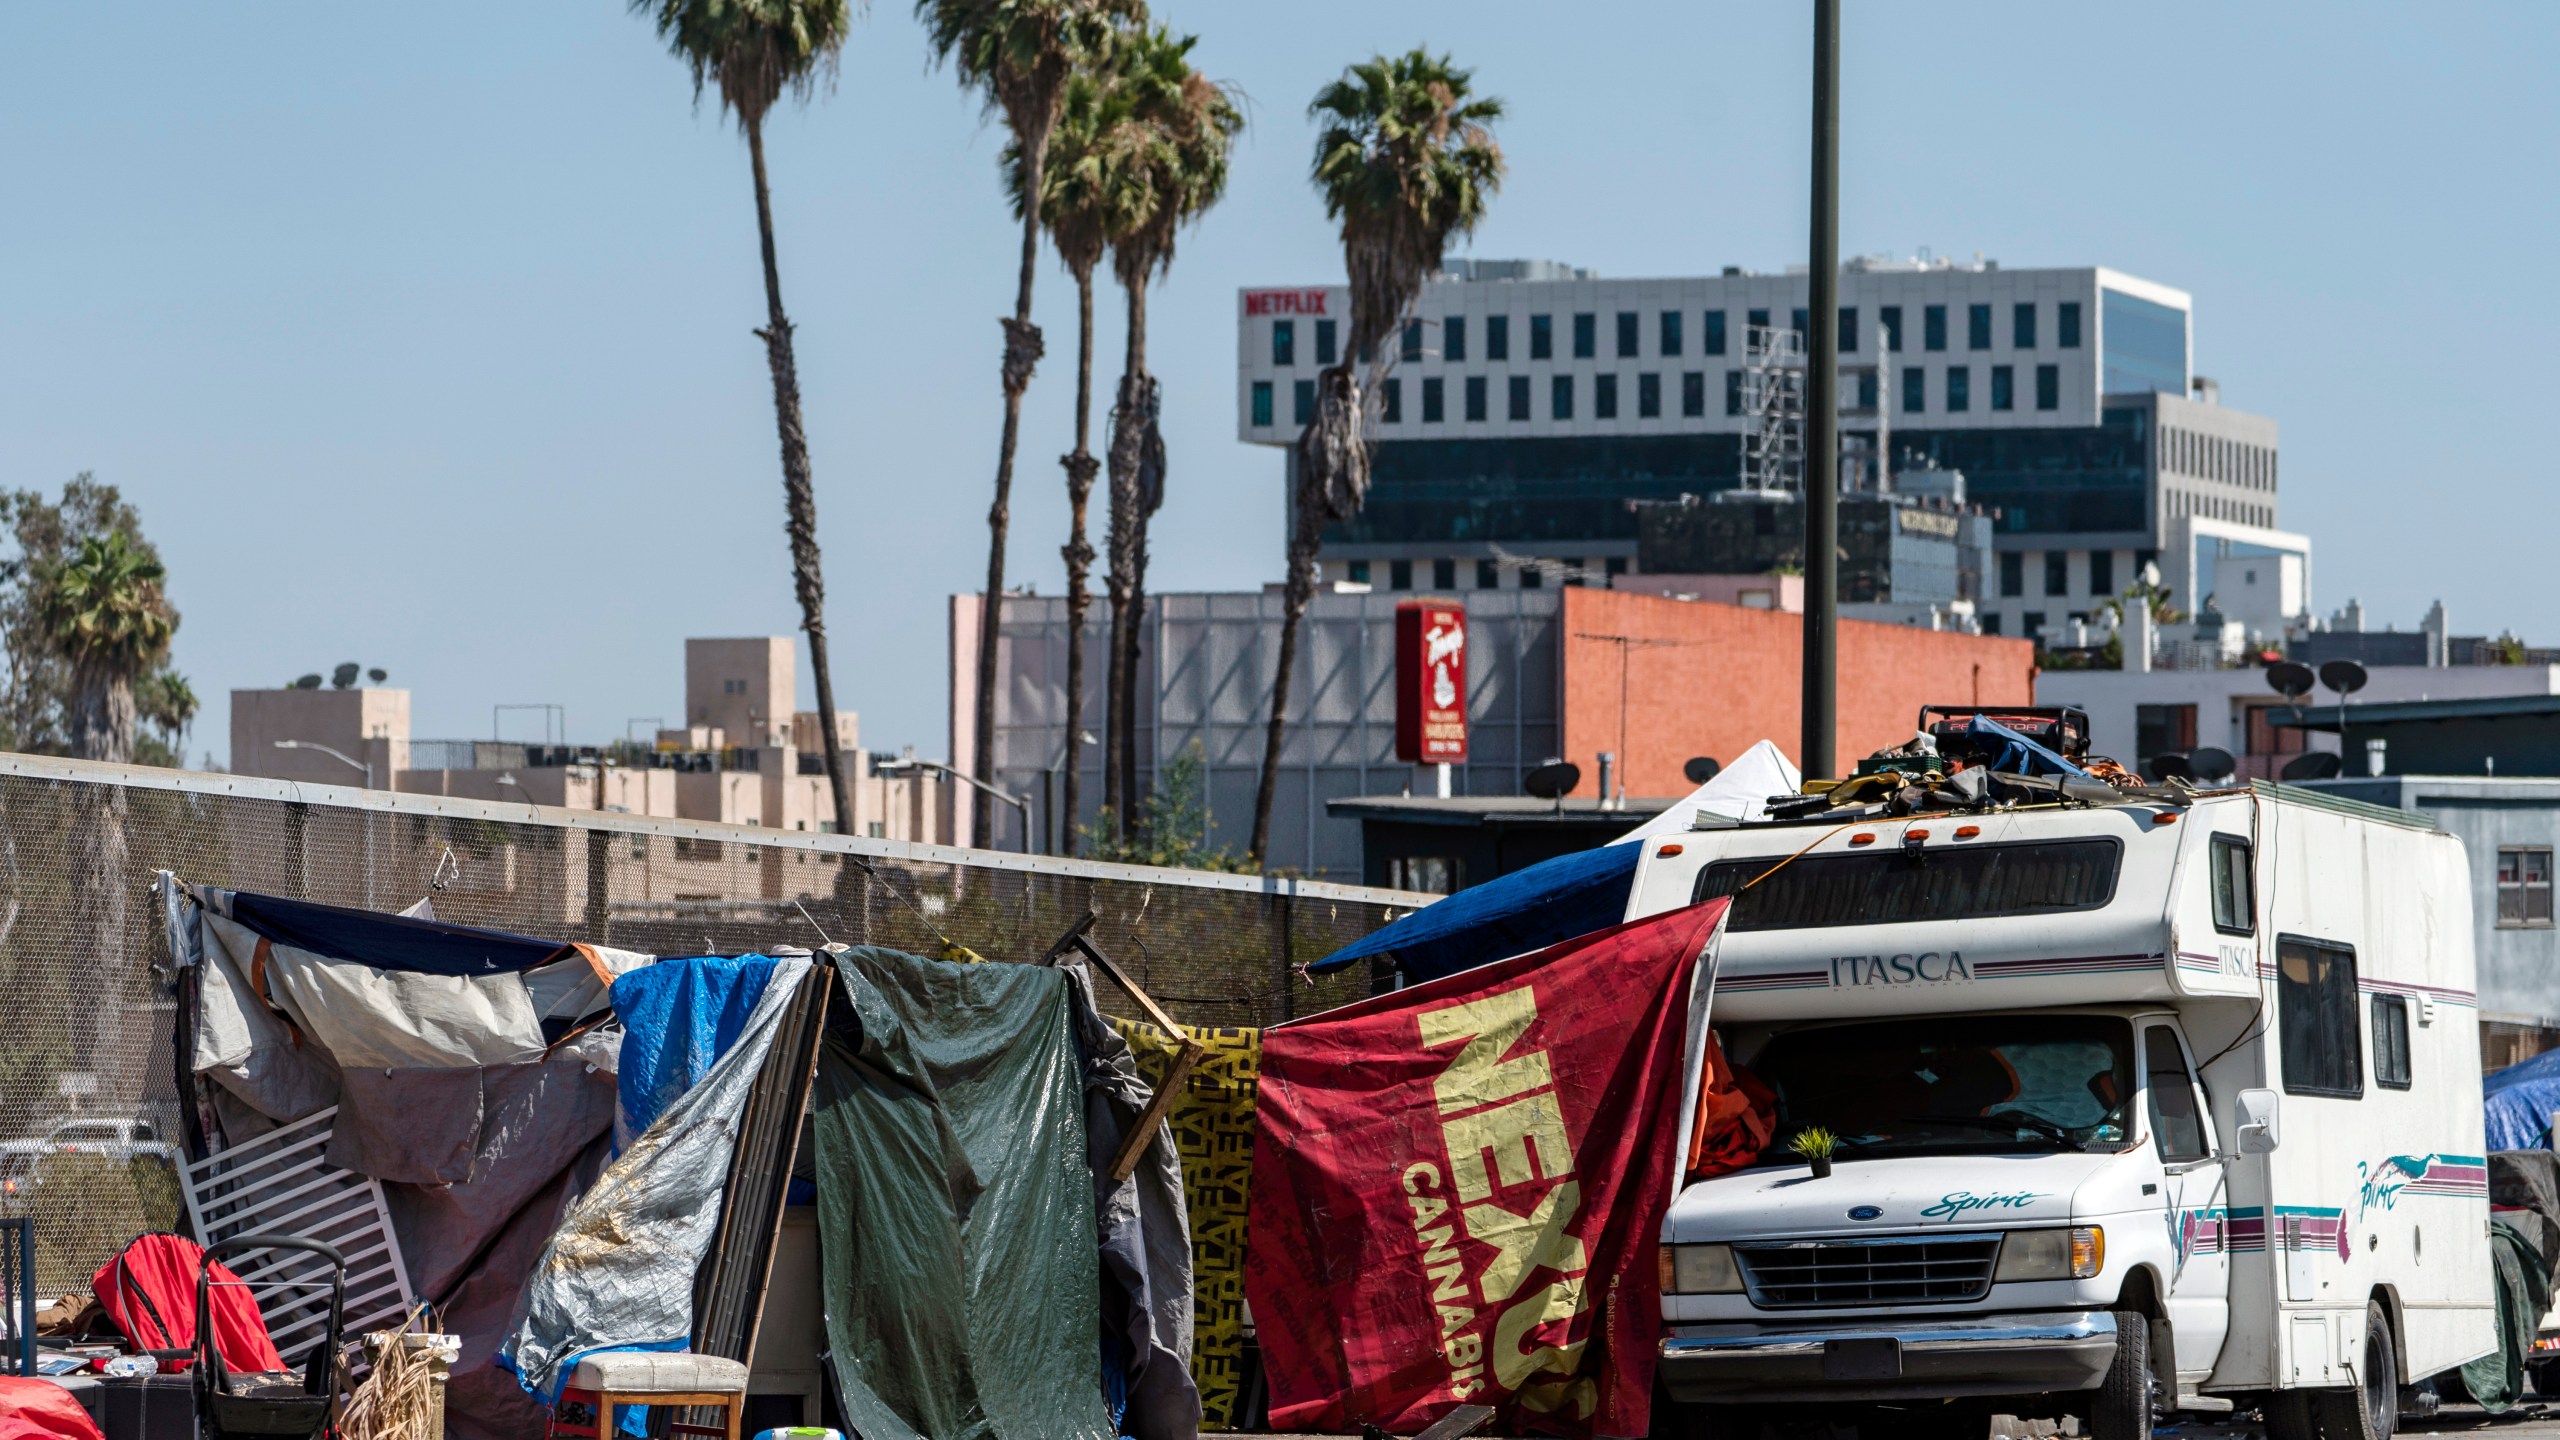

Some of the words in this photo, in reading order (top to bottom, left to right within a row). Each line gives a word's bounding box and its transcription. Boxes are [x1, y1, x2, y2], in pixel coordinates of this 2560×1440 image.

[1246, 289, 1327, 317] NETFLIX
[1949, 723, 2038, 731] PRTOR
[1830, 951, 1972, 987] ITASCA
[2219, 945, 2255, 978] ITASCA
[1921, 1191, 2055, 1222] Spirit
[1403, 1161, 1486, 1400] CANNABIS
